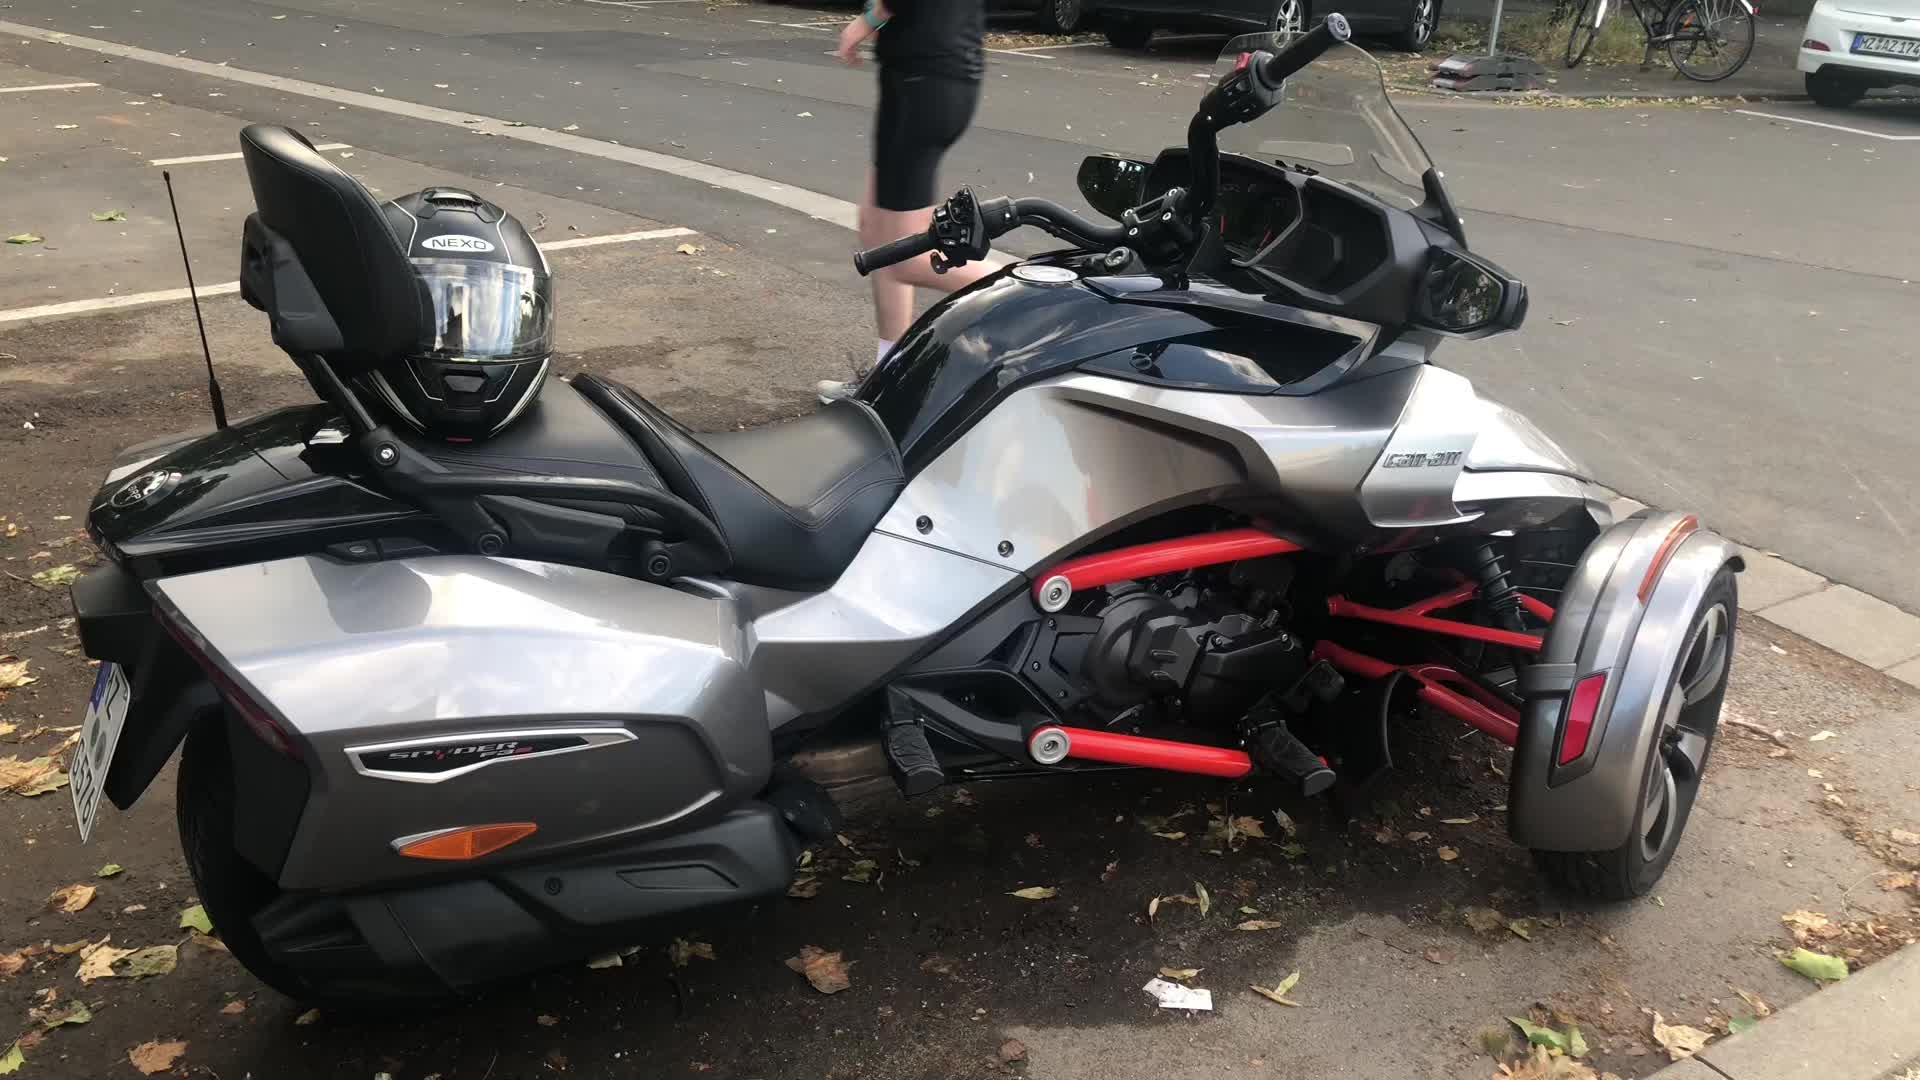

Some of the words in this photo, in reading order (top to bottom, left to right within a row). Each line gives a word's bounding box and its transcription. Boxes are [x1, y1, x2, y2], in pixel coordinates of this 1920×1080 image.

[1882, 39, 1898, 53] AZ
[431, 238, 487, 250] NEXO
[388, 741, 519, 761] SPYDER
